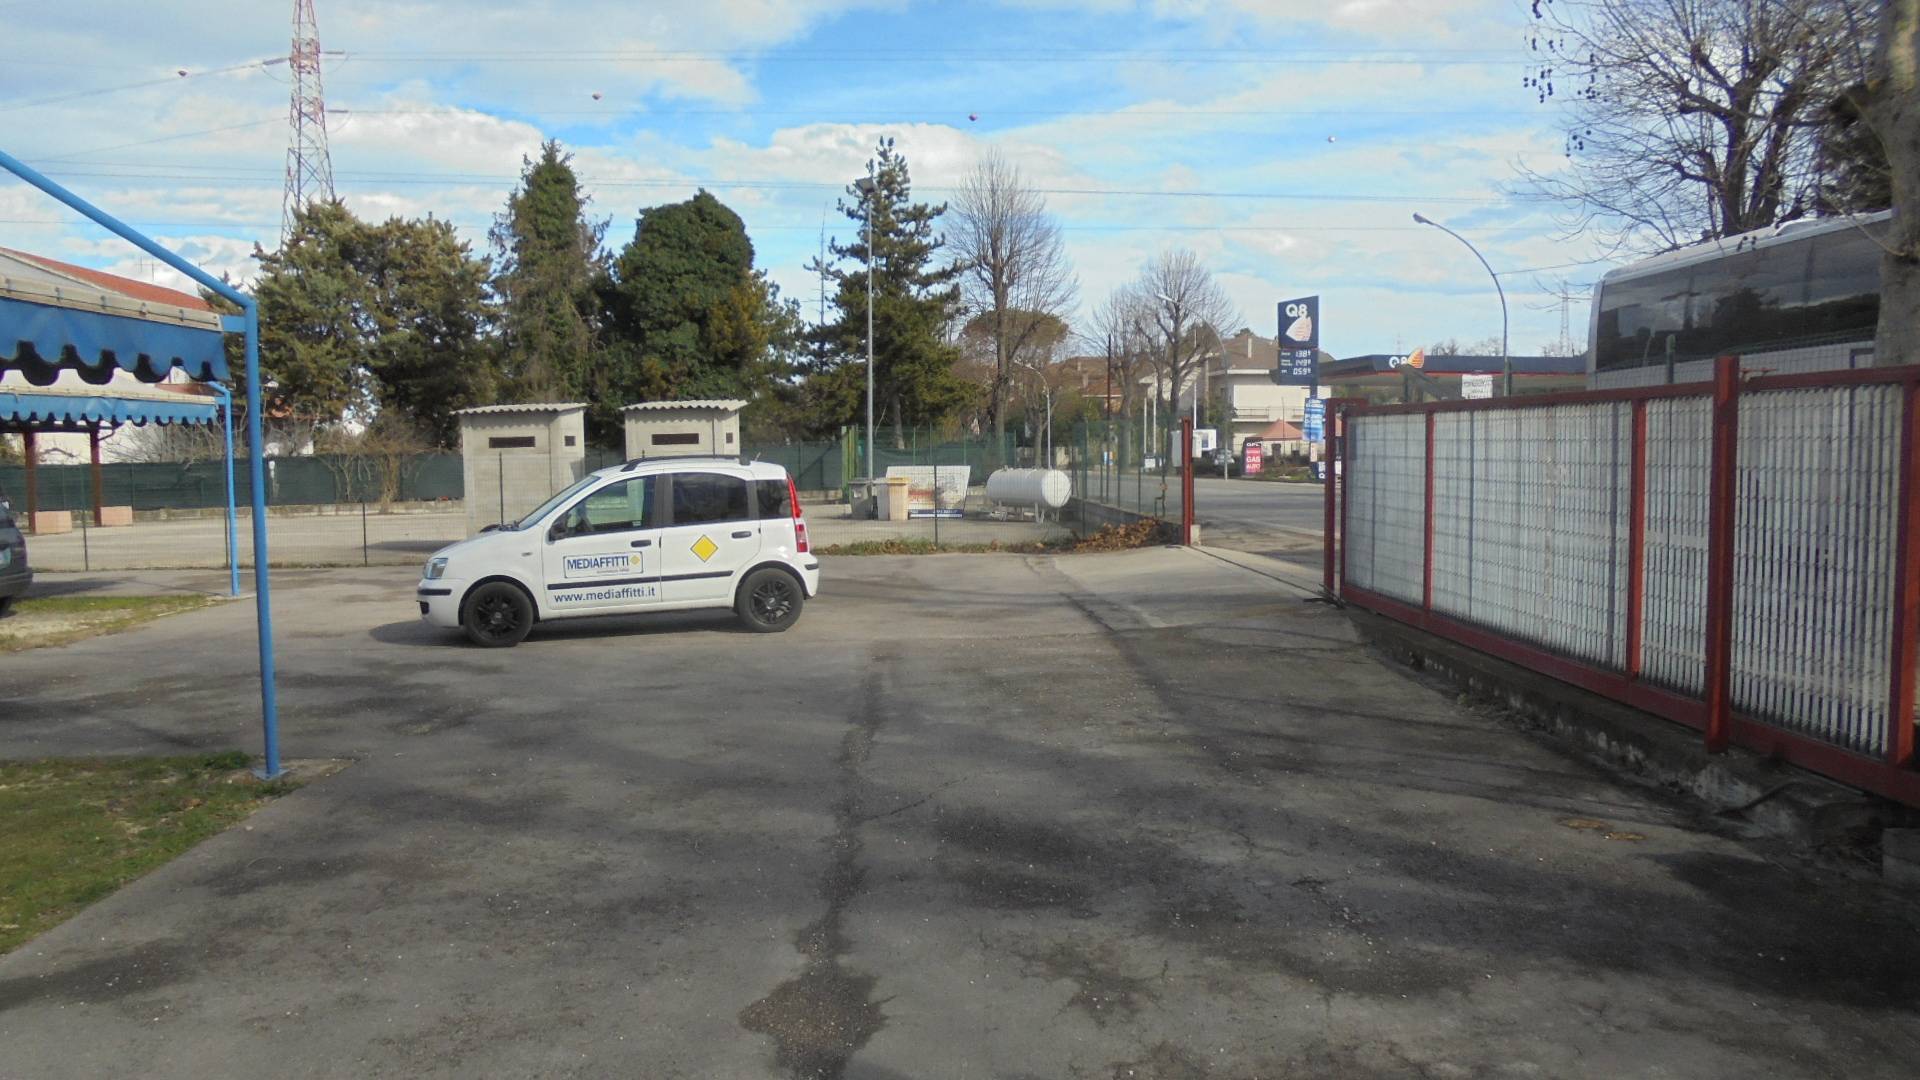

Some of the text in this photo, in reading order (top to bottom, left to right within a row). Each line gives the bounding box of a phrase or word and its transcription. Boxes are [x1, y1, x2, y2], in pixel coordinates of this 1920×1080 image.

[1286, 303, 1308, 317] Q8
[567, 556, 629, 570] MEDIAFFITTI
[554, 587, 655, 602] www.mediaffitti.it
